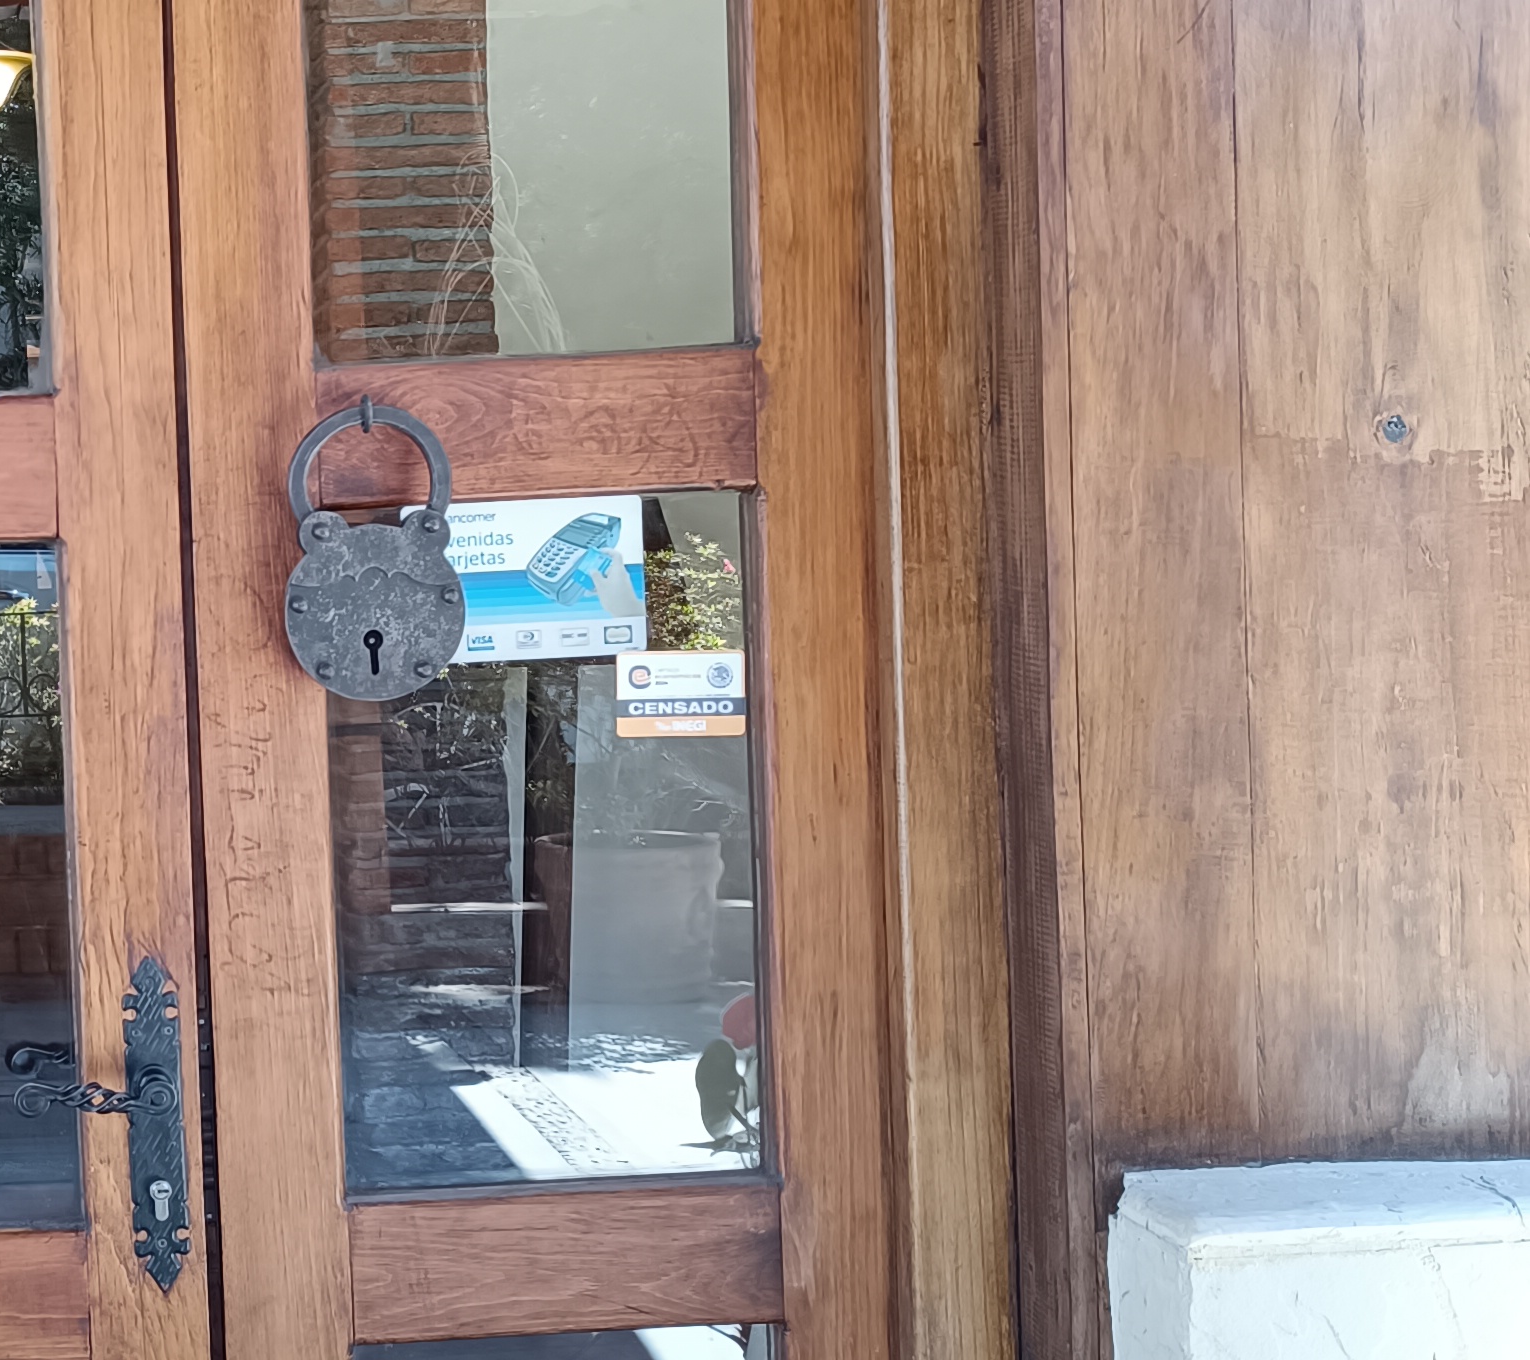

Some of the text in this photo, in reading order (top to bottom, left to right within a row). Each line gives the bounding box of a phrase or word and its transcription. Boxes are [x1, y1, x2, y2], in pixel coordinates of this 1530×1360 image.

[447, 513, 496, 523] ancomer
[448, 531, 514, 547] venidas
[447, 551, 506, 569] arjetas
[471, 635, 493, 644] VISA
[628, 700, 734, 715] CENSADO
